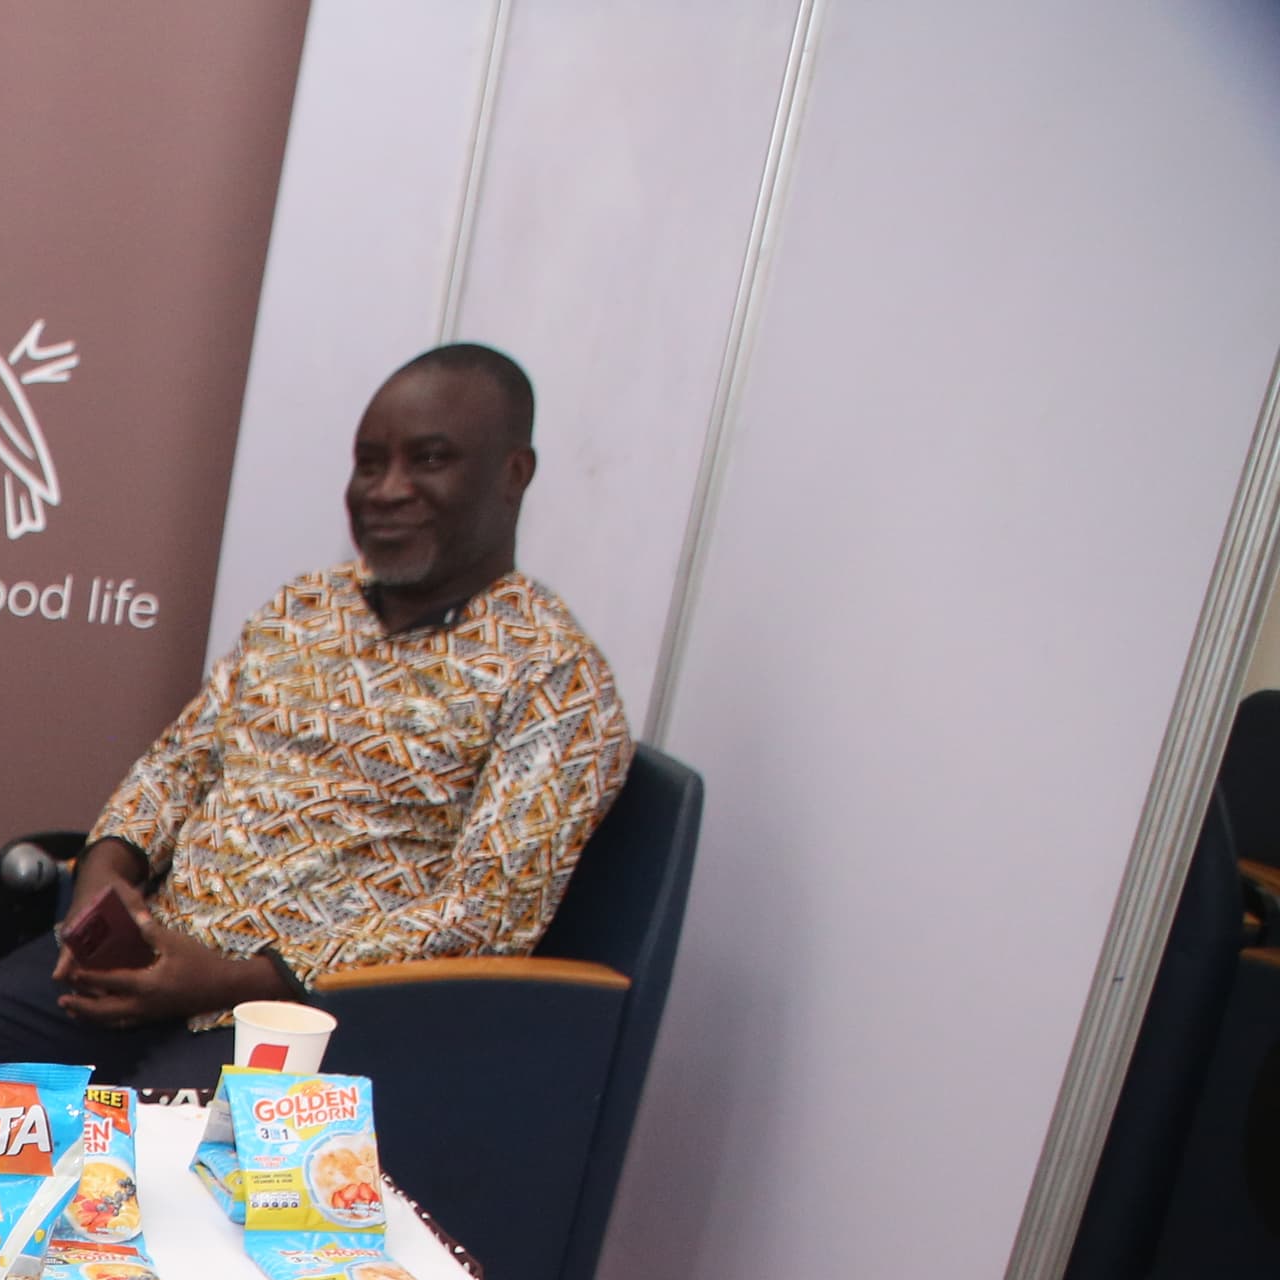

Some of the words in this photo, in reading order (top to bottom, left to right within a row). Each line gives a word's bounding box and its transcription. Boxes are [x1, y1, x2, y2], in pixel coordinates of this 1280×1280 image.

[87, 577, 161, 630] life
[254, 1086, 359, 1122] GOLDEN
[296, 1107, 356, 1127] MORN
